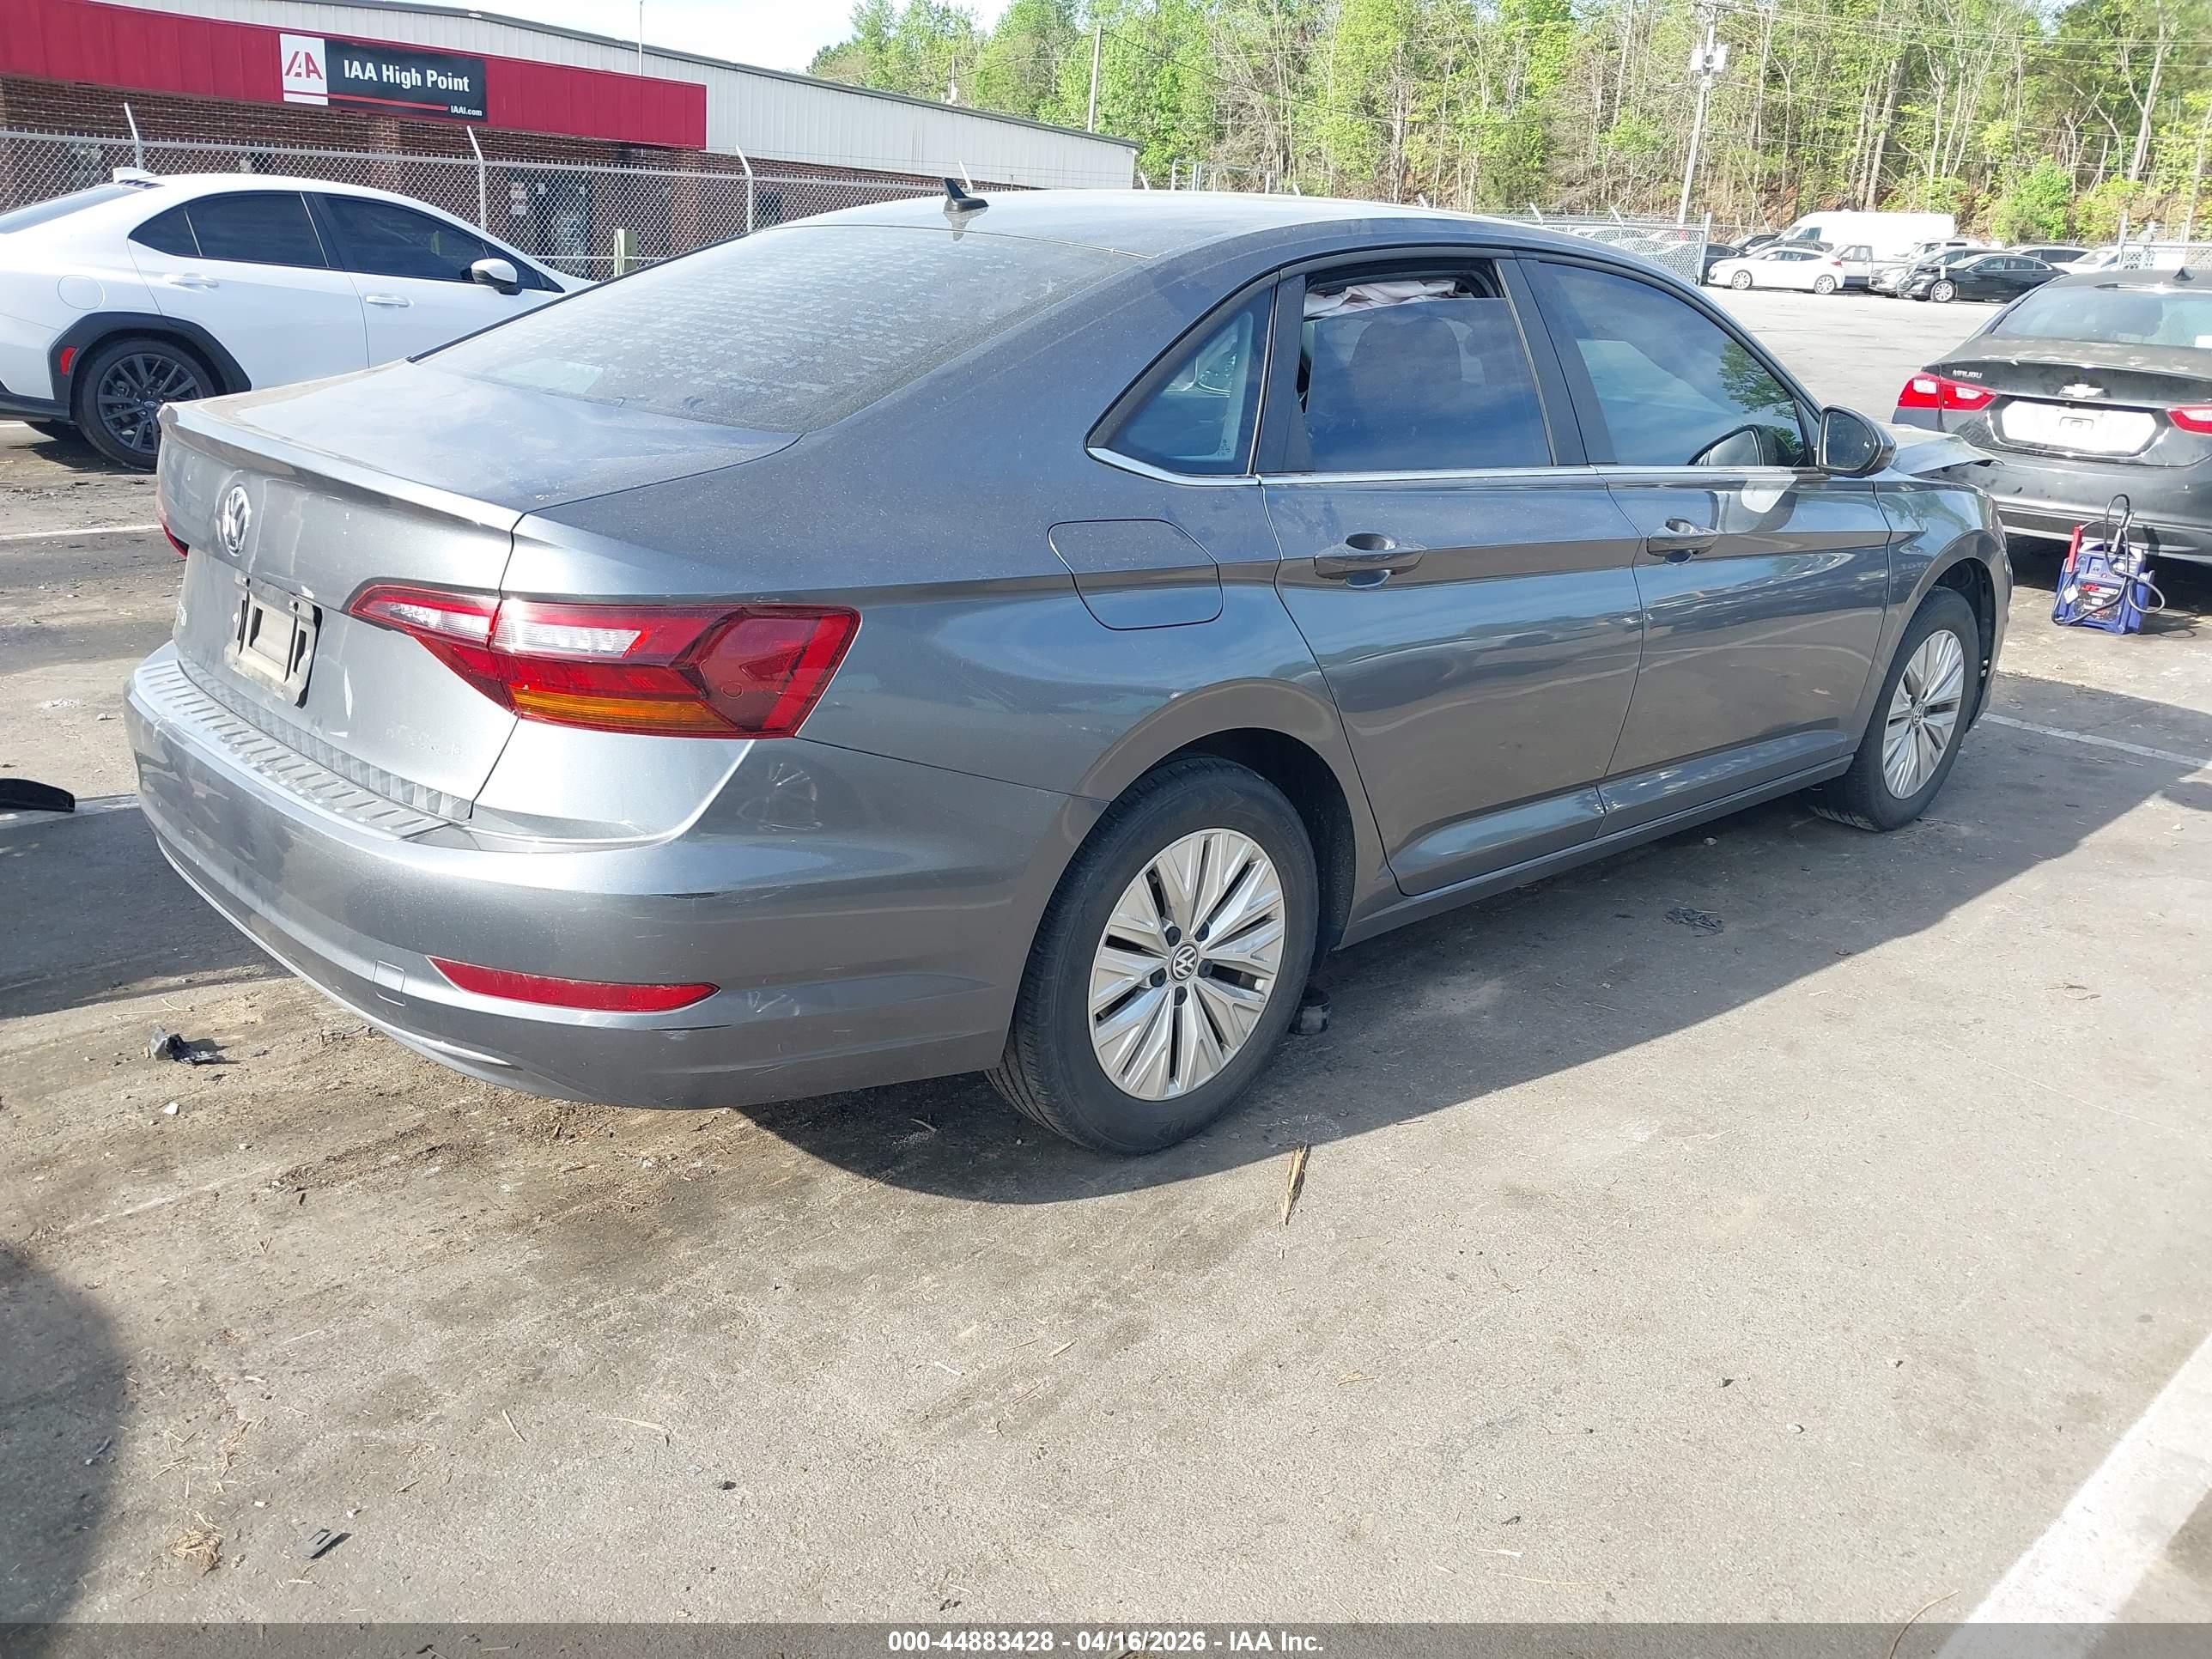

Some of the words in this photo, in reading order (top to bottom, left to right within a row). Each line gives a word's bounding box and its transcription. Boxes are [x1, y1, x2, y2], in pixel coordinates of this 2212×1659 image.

[343, 59, 378, 82] IAA
[382, 64, 422, 89] High
[426, 69, 470, 92] Point
